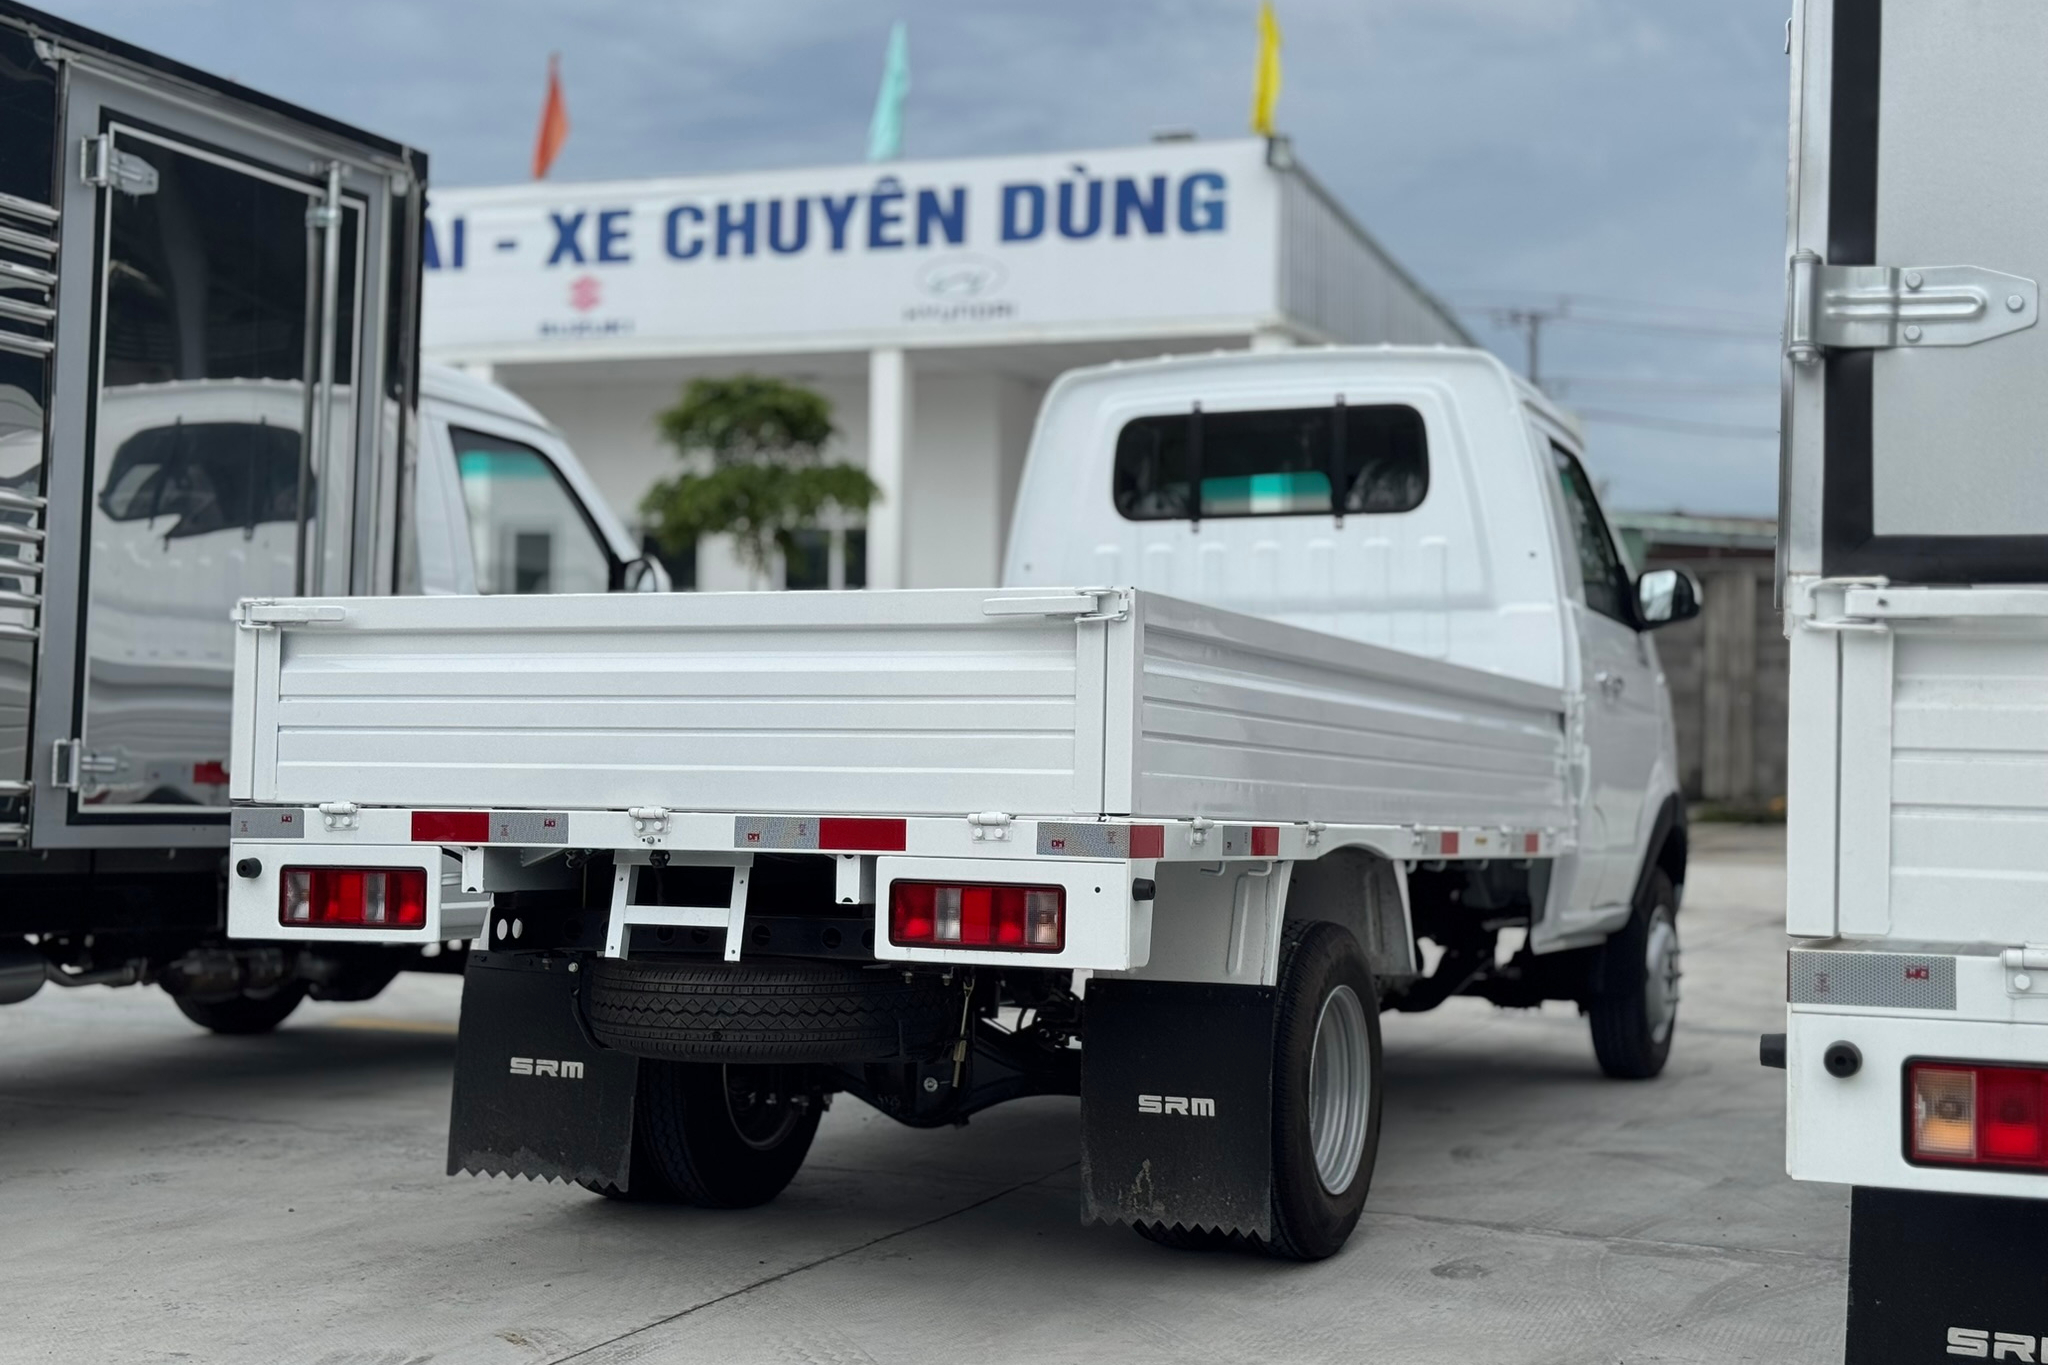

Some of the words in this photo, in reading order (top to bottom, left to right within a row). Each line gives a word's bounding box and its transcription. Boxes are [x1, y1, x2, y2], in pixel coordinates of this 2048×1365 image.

[549, 210, 631, 264] XE
[666, 176, 966, 259] CHUYÊN
[1002, 163, 1225, 242] DÙNG
[509, 1057, 584, 1079] SRM
[1138, 1094, 1216, 1117] SRM
